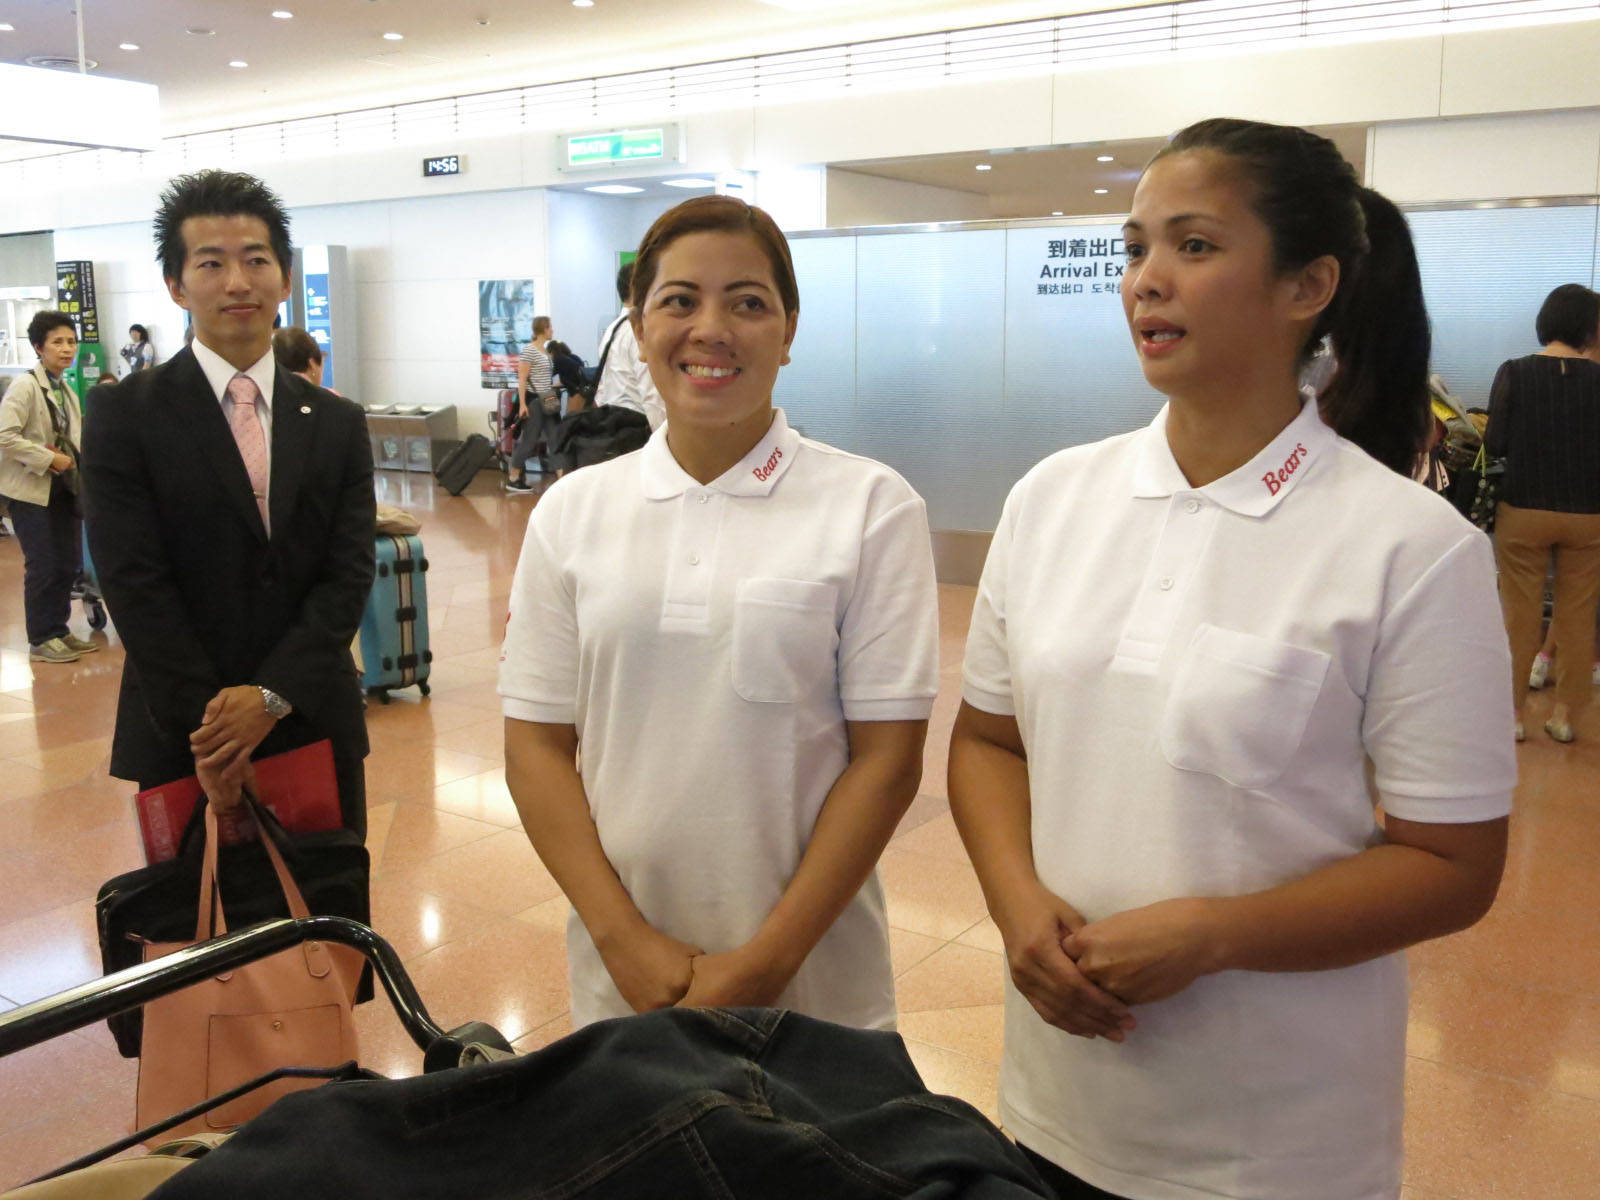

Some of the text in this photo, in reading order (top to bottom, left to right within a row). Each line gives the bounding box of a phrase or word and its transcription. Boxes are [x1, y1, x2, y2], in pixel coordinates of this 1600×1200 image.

[428, 157, 457, 173] 14:56
[1047, 238, 1126, 259] 到着出口
[1040, 261, 1124, 279] Arrival Ex
[1036, 283, 1083, 295] 到达出口
[752, 446, 783, 482] Bears
[1261, 442, 1307, 496] Bears
